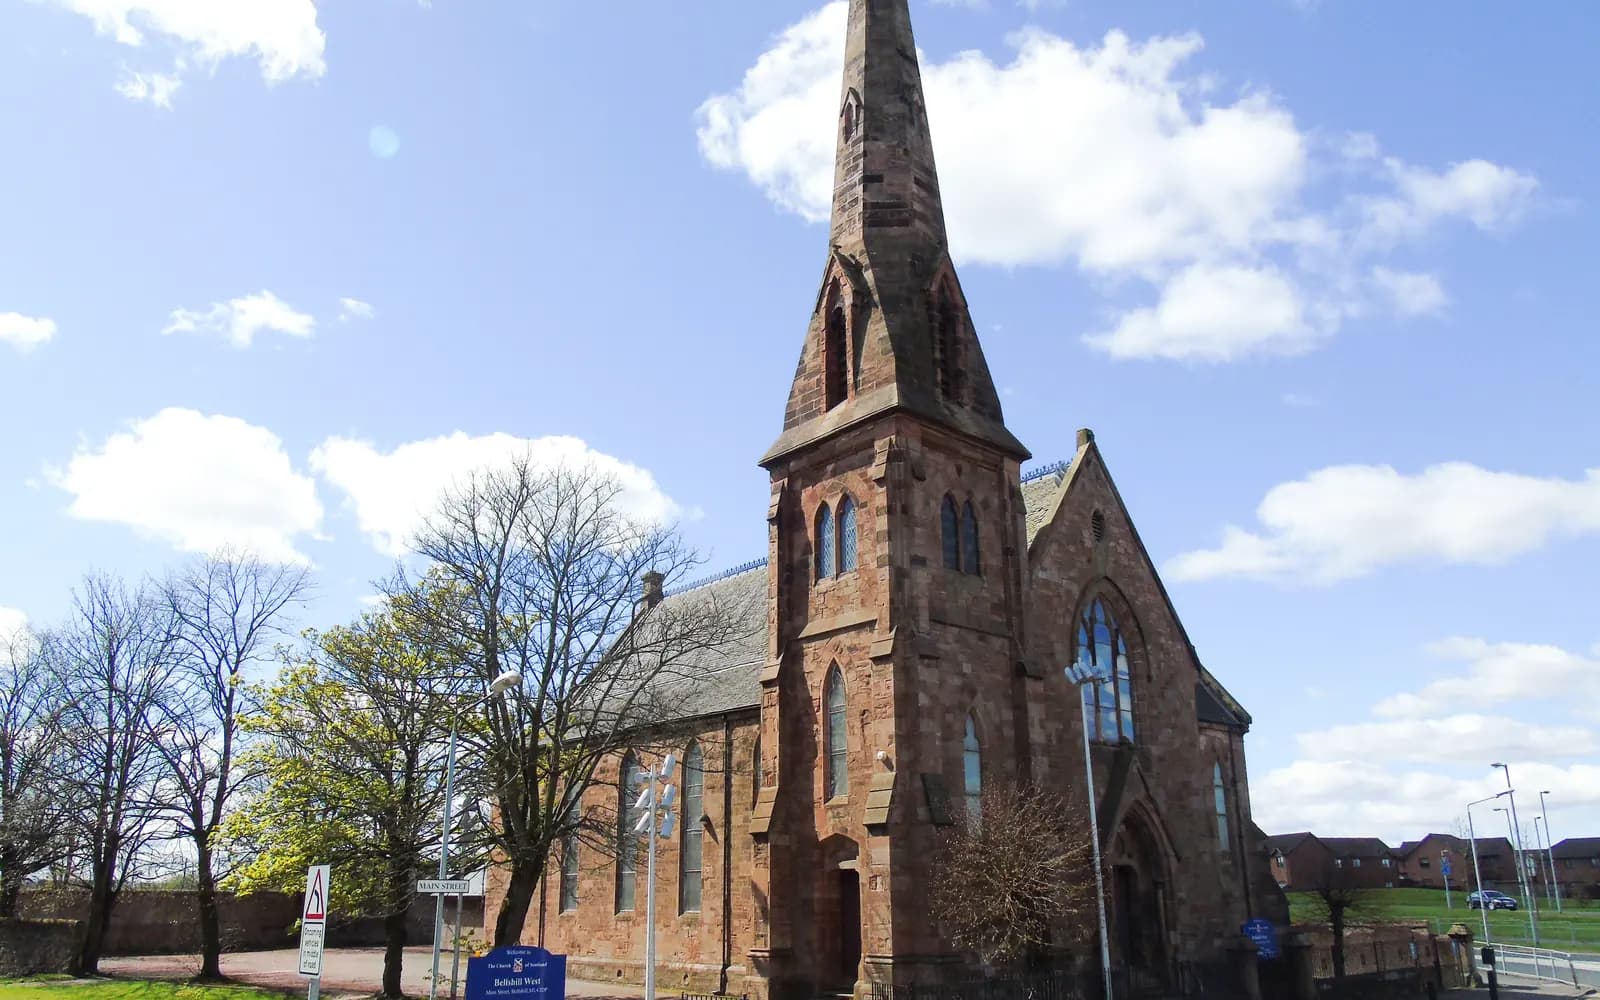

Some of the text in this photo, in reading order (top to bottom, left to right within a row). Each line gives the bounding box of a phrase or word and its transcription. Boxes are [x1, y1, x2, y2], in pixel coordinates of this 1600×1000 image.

[419, 882, 468, 890] MAIN STREET
[494, 976, 541, 987] Bellshill West
